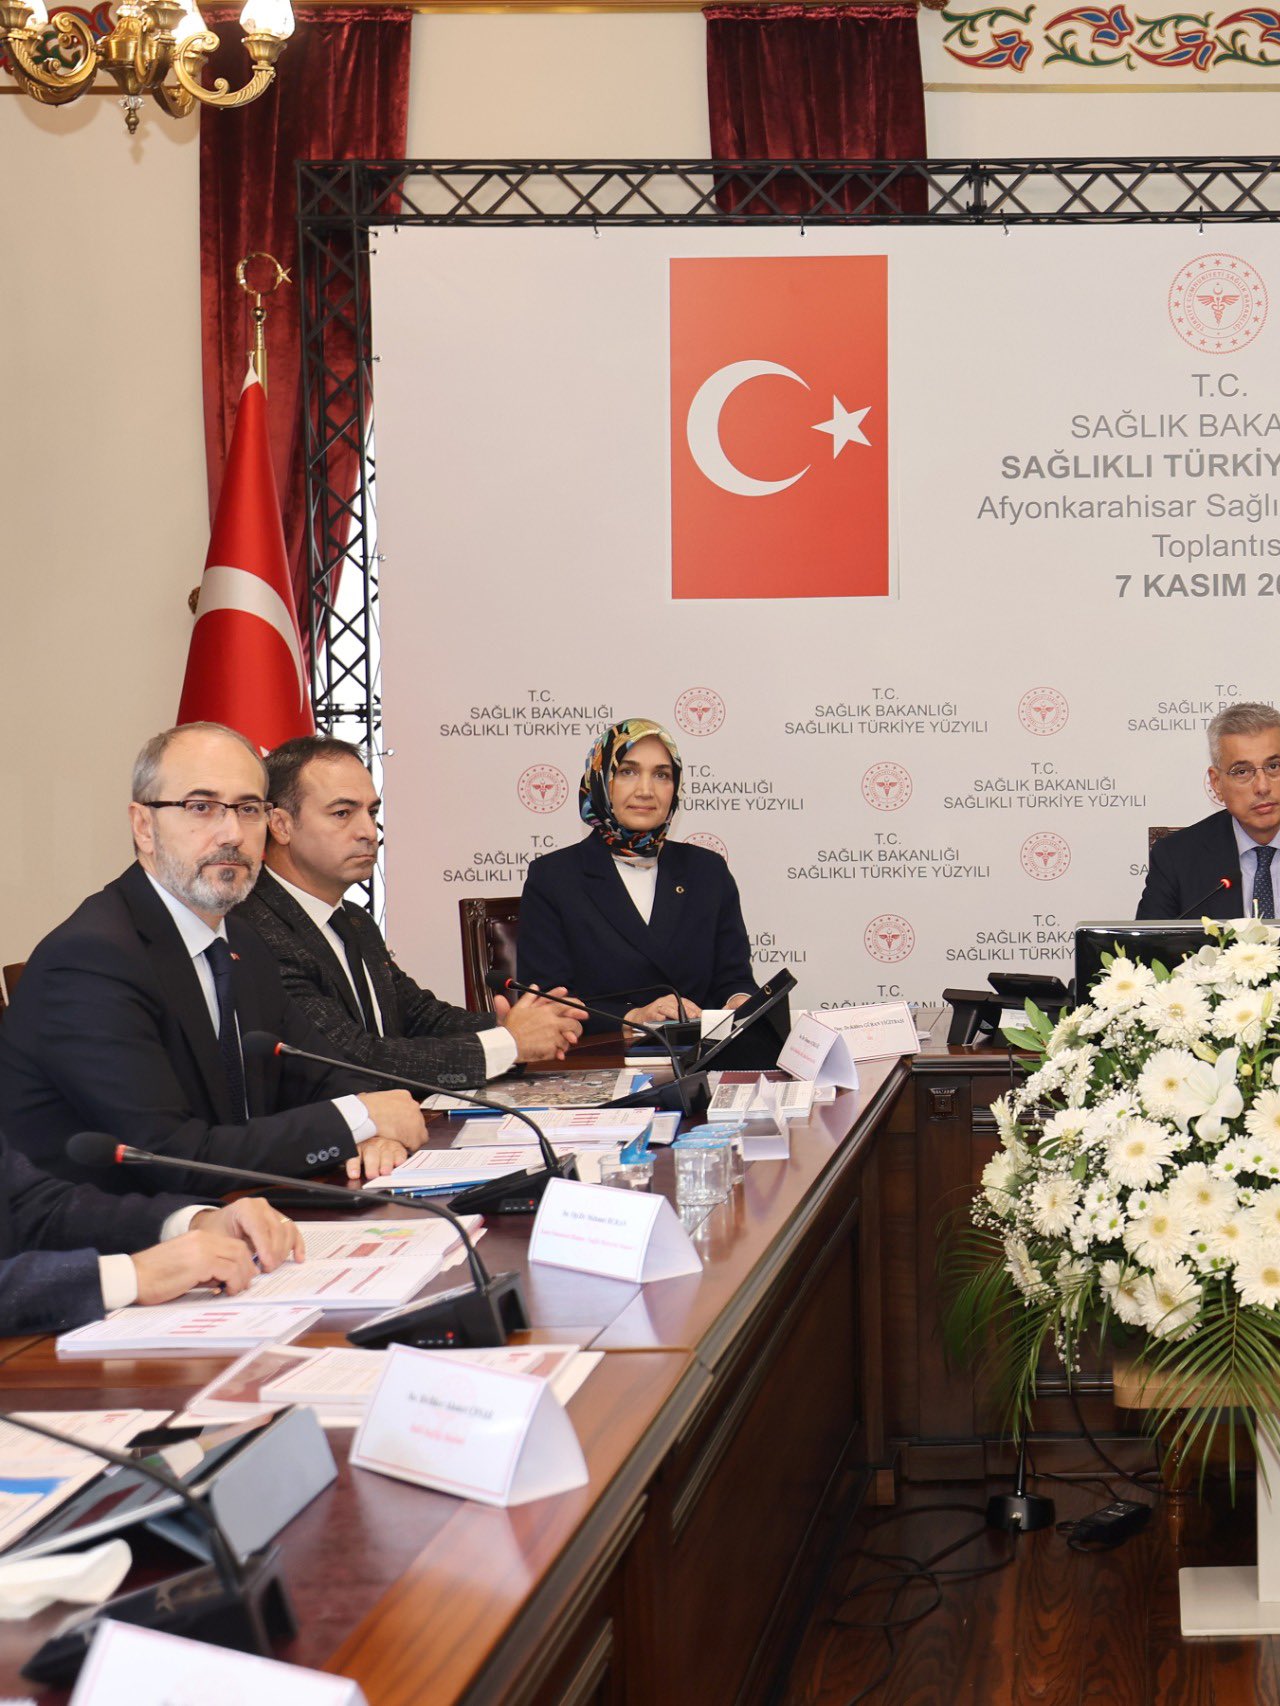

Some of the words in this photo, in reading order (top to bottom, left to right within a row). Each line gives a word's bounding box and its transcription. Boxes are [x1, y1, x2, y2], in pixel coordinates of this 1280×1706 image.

[1191, 374, 1247, 397] T.C.
[1071, 409, 1188, 438] SAĞLIK
[1002, 449, 1152, 479] SAĞLIKLI
[977, 495, 1196, 525] Afyonkarahisar
[1116, 575, 1131, 597] 7
[1144, 574, 1245, 597] KASIM
[528, 690, 555, 702] T.C.
[872, 688, 899, 700] T.C.
[1215, 685, 1242, 697] T.C.
[471, 705, 526, 719] SAĞLIK
[532, 705, 612, 719] BAKANLIĞI
[815, 703, 870, 717] SAĞLIK
[876, 702, 956, 716] BAKANLIĞI
[1158, 700, 1213, 714] SAĞLIK
[440, 722, 508, 736] SAĞLIKLI
[514, 722, 580, 736] TÜRKİYE
[785, 720, 853, 734] SAĞLIKLI
[858, 719, 924, 733] TÜRKİYE
[930, 719, 987, 733] YÜZYILI
[1128, 717, 1195, 731] SAĞLIKLI
[688, 765, 715, 777] T.C.
[1031, 762, 1058, 774] T.C.
[692, 780, 772, 794] BAKANLIĞI
[974, 777, 1030, 791] SAĞLIK
[1035, 776, 1115, 791] BAKANLIĞI
[746, 796, 803, 810] YÜZYILI
[944, 794, 1012, 809] SAĞLIKLI
[1017, 793, 1083, 808] TÜRKİYE
[1088, 793, 1146, 807] YÜZYILI
[531, 835, 558, 847] T.C.
[875, 833, 902, 845] T.C.
[474, 851, 529, 865] SAĞLIK
[818, 848, 873, 862] SAĞLIK
[878, 848, 959, 861] BAKANLIĞI
[443, 868, 511, 882] SAĞLIKLI
[787, 865, 855, 879] SAĞLIKLI
[860, 864, 927, 878] TÜRKİYE
[932, 864, 989, 877] YÜZYILI
[1033, 915, 1060, 927] T.C.
[976, 930, 1031, 944] SAĞLIK
[946, 947, 1013, 961] SAĞLIKLI
[1019, 946, 1074, 961] TÜRKİY
[877, 985, 904, 997] T.C.
